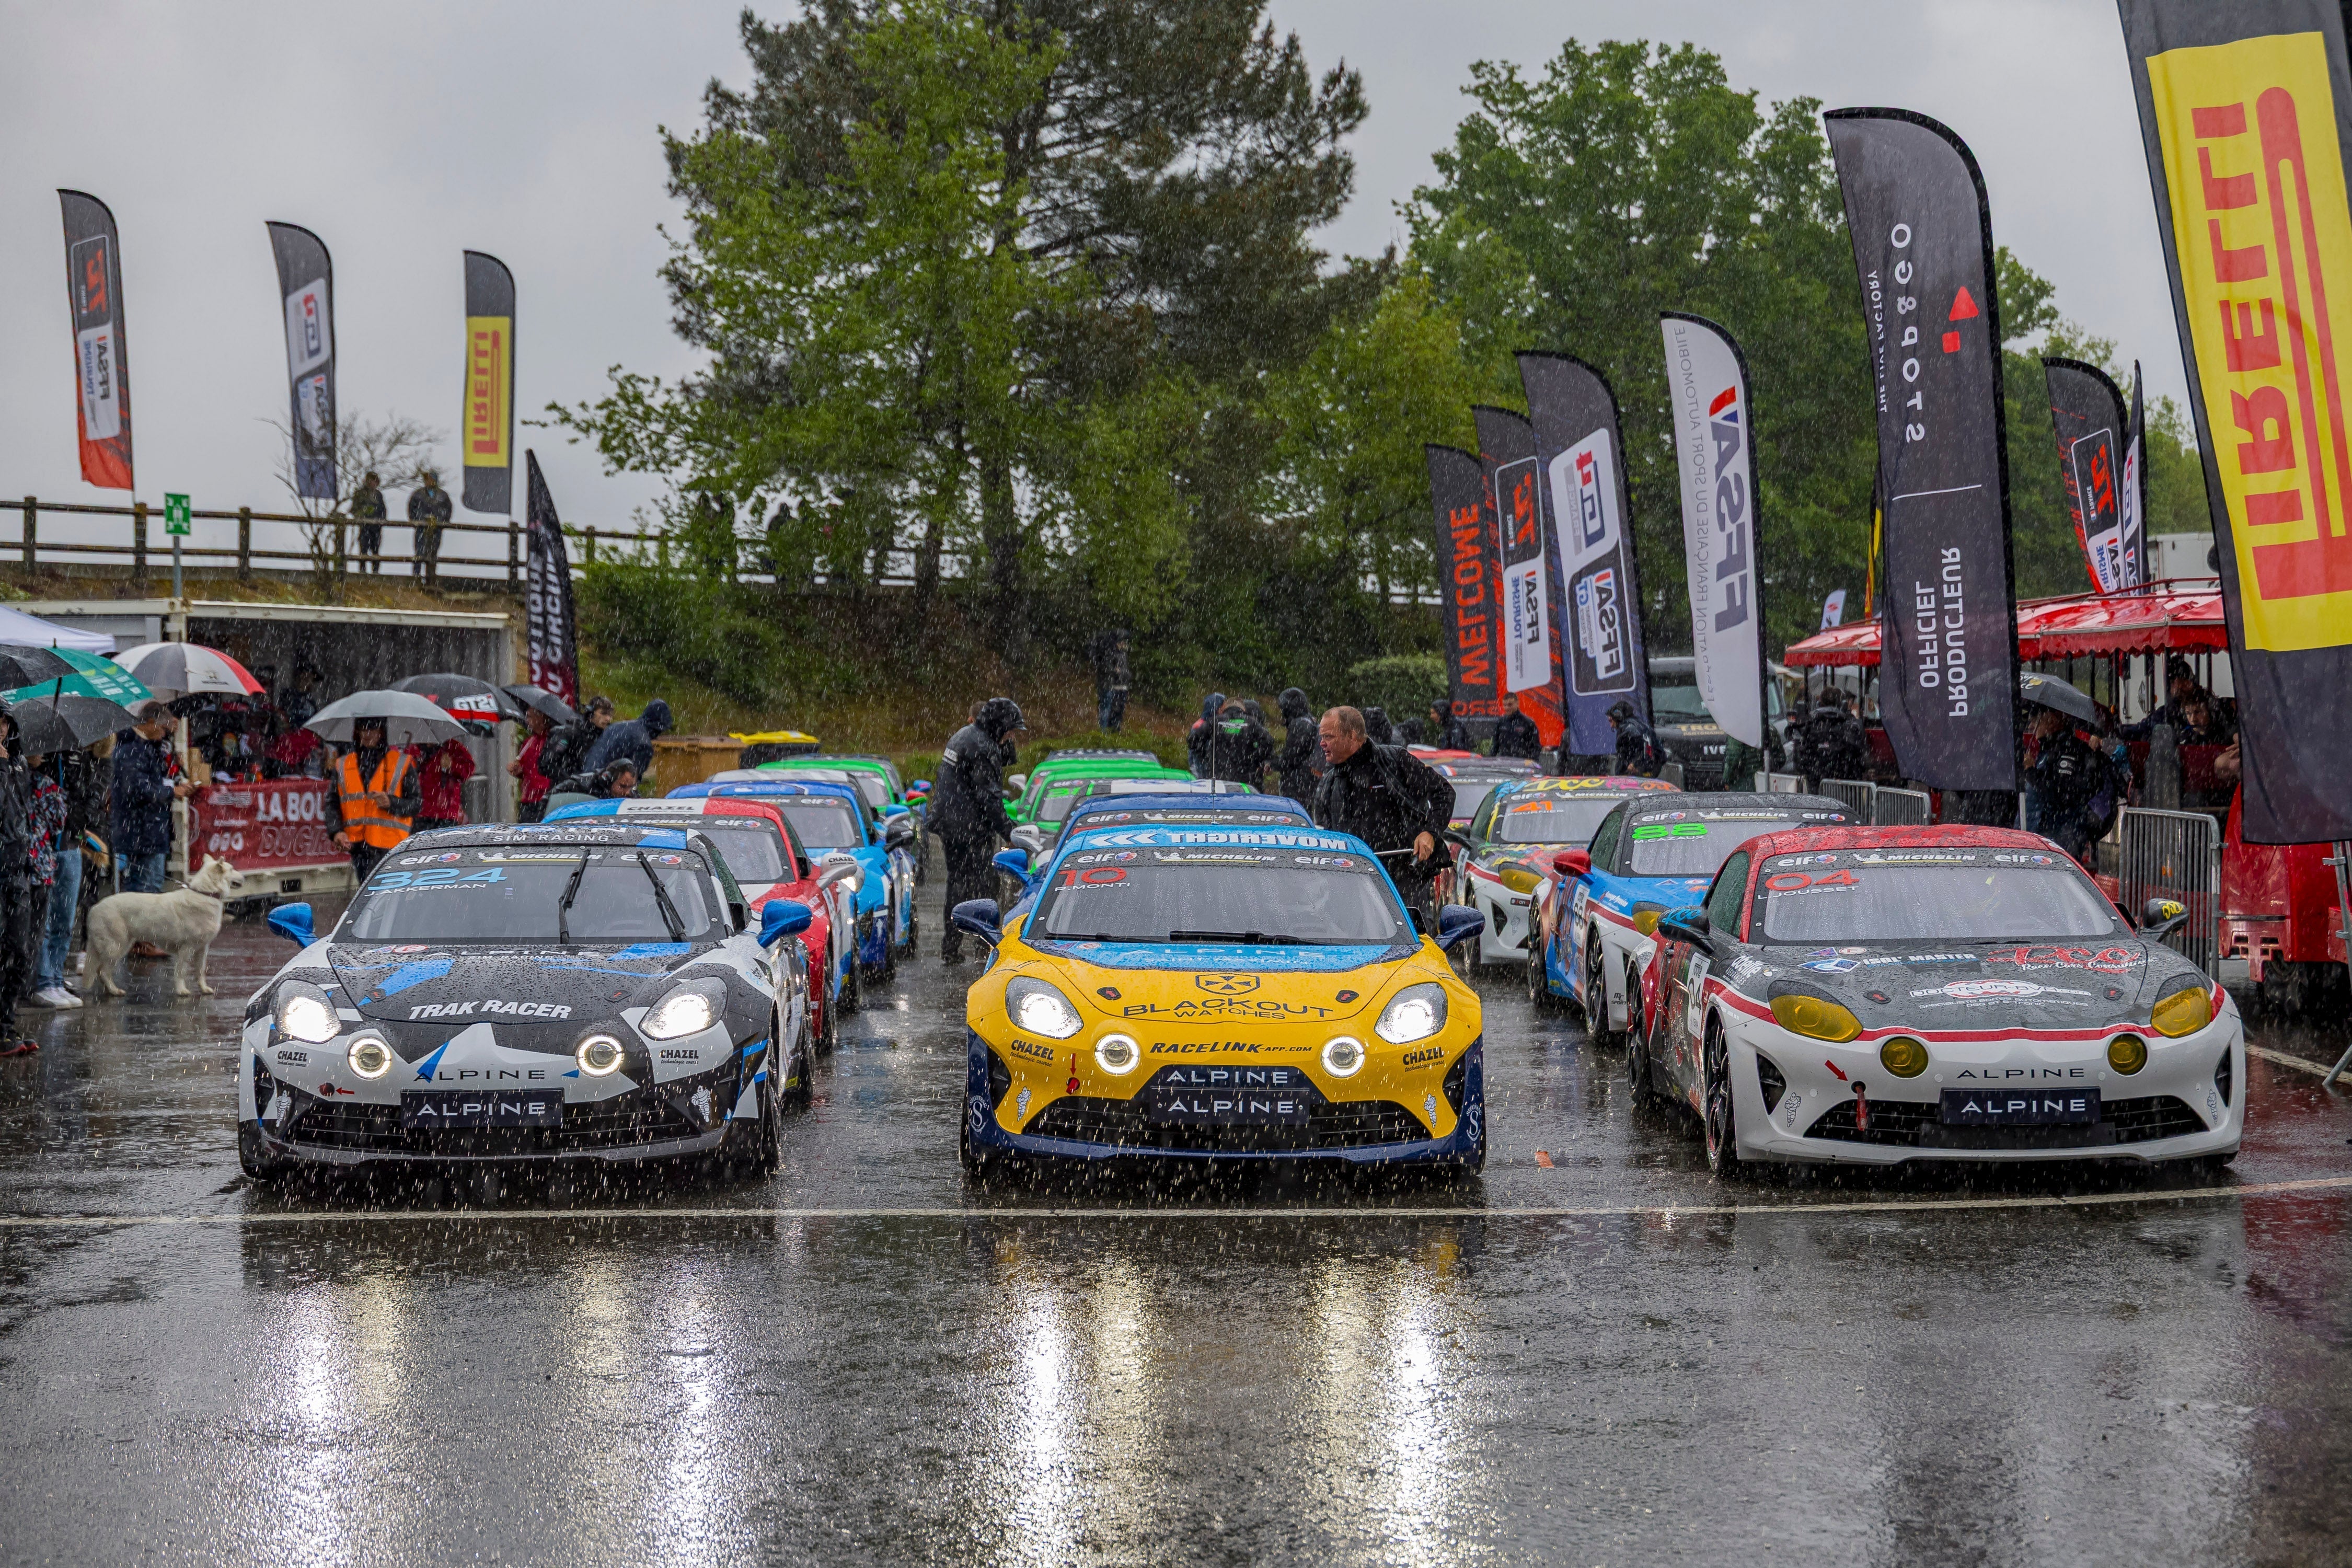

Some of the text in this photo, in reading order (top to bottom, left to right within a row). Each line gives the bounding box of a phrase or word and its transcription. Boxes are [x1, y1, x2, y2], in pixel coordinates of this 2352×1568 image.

[256, 791, 284, 822] LA
[1512, 801, 1553, 813] 41
[1087, 814, 1115, 823] elf
[1632, 823, 1708, 839] 88
[1634, 835, 1705, 844] M.CAZAUX
[400, 855, 439, 865] elf
[1078, 854, 1115, 863] elf
[1778, 856, 1816, 867] elf
[1994, 855, 2030, 863] elf
[368, 868, 508, 891] 324
[1057, 867, 1127, 884] 10
[1765, 869, 1859, 891] 04
[364, 883, 487, 897] J.AKKERMAN
[1054, 882, 1131, 892] R.MONTI
[1123, 948, 1324, 958] ALPINE
[409, 999, 572, 1020] TRAK RACER
[1124, 997, 1334, 1018] BLACKOUT
[1174, 1008, 1286, 1020] WATCHES
[659, 1049, 699, 1059] CHAZEL
[1011, 1039, 1055, 1061] CHAZEL
[1150, 1042, 1312, 1053] RACELINK-APP.COM
[278, 1050, 307, 1062] CHAZEL
[1010, 1051, 1053, 1067] technologie course
[1403, 1047, 1445, 1065] CHAZEL
[413, 1069, 546, 1081] ALPINE
[1167, 1070, 1288, 1083] ALPINE
[1956, 1068, 2084, 1079] ALPINE
[418, 1102, 546, 1116] ALPINE
[1168, 1100, 1293, 1113] ALPINE
[1961, 1099, 2085, 1113] ALPINE
[972, 1101, 983, 1126] S
[1470, 1110, 1479, 1135] S
